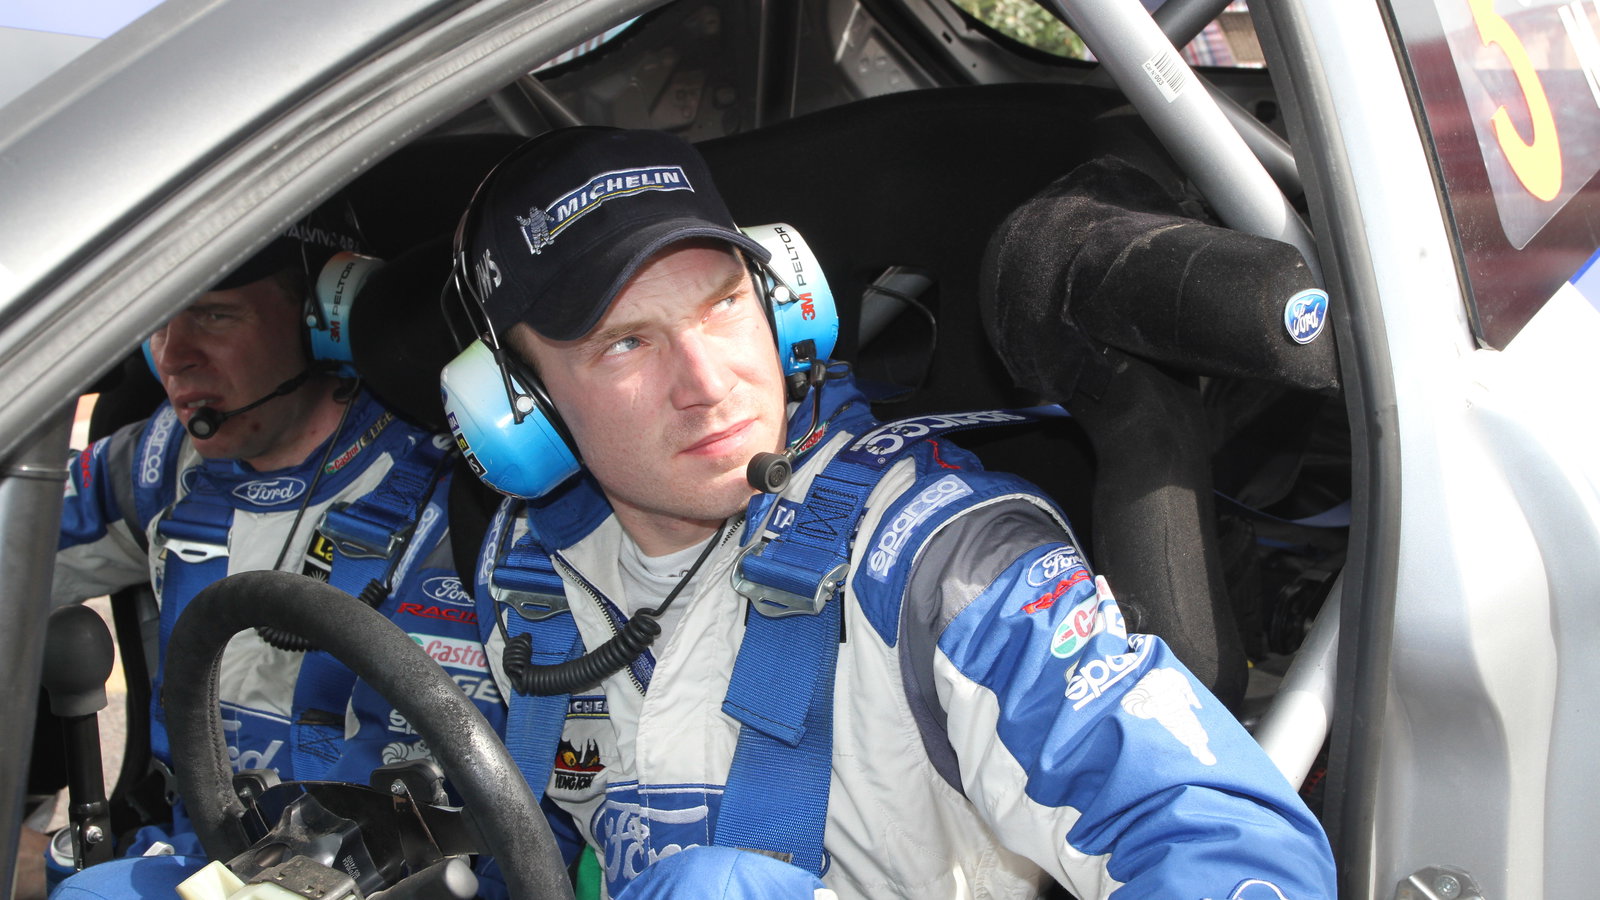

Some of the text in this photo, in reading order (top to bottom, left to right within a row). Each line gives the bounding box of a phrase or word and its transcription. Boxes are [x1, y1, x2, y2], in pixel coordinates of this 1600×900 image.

[557, 172, 681, 222] MICHELIN
[774, 226, 816, 321] 3M PELTOR
[330, 262, 355, 343] 3M PELTOR
[1293, 298, 1320, 337] Ford
[334, 444, 360, 470] Castrol
[247, 480, 294, 501] Ford
[870, 481, 966, 577] sparco
[1042, 546, 1083, 580] For
[435, 577, 476, 603] For
[422, 639, 489, 669] Castro
[451, 675, 501, 704] GE
